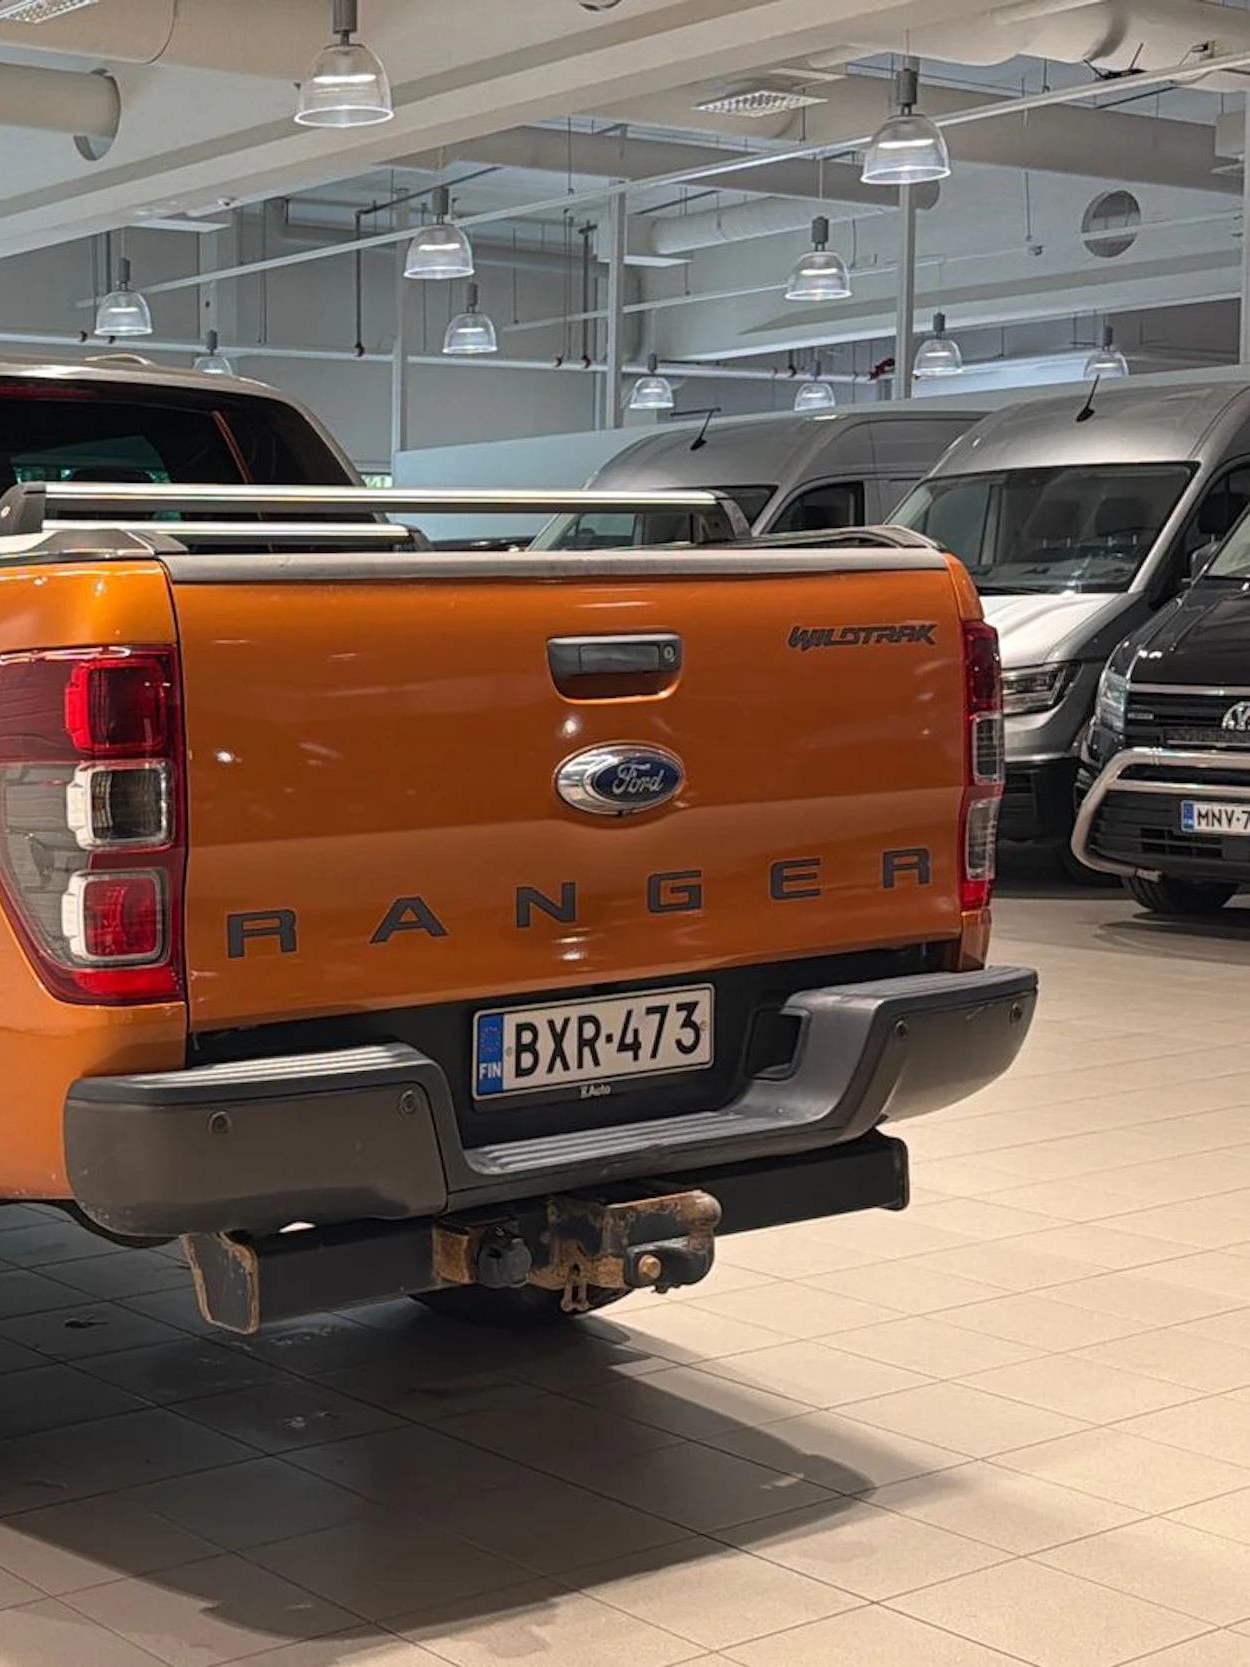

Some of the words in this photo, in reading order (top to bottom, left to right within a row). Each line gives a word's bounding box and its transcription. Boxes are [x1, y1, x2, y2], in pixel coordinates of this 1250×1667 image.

[788, 624, 938, 651] WILDTRAK
[612, 762, 665, 795] Ford
[226, 847, 932, 958] RANGER
[515, 1001, 701, 1079] BXR-473
[479, 1062, 501, 1081] FIN
